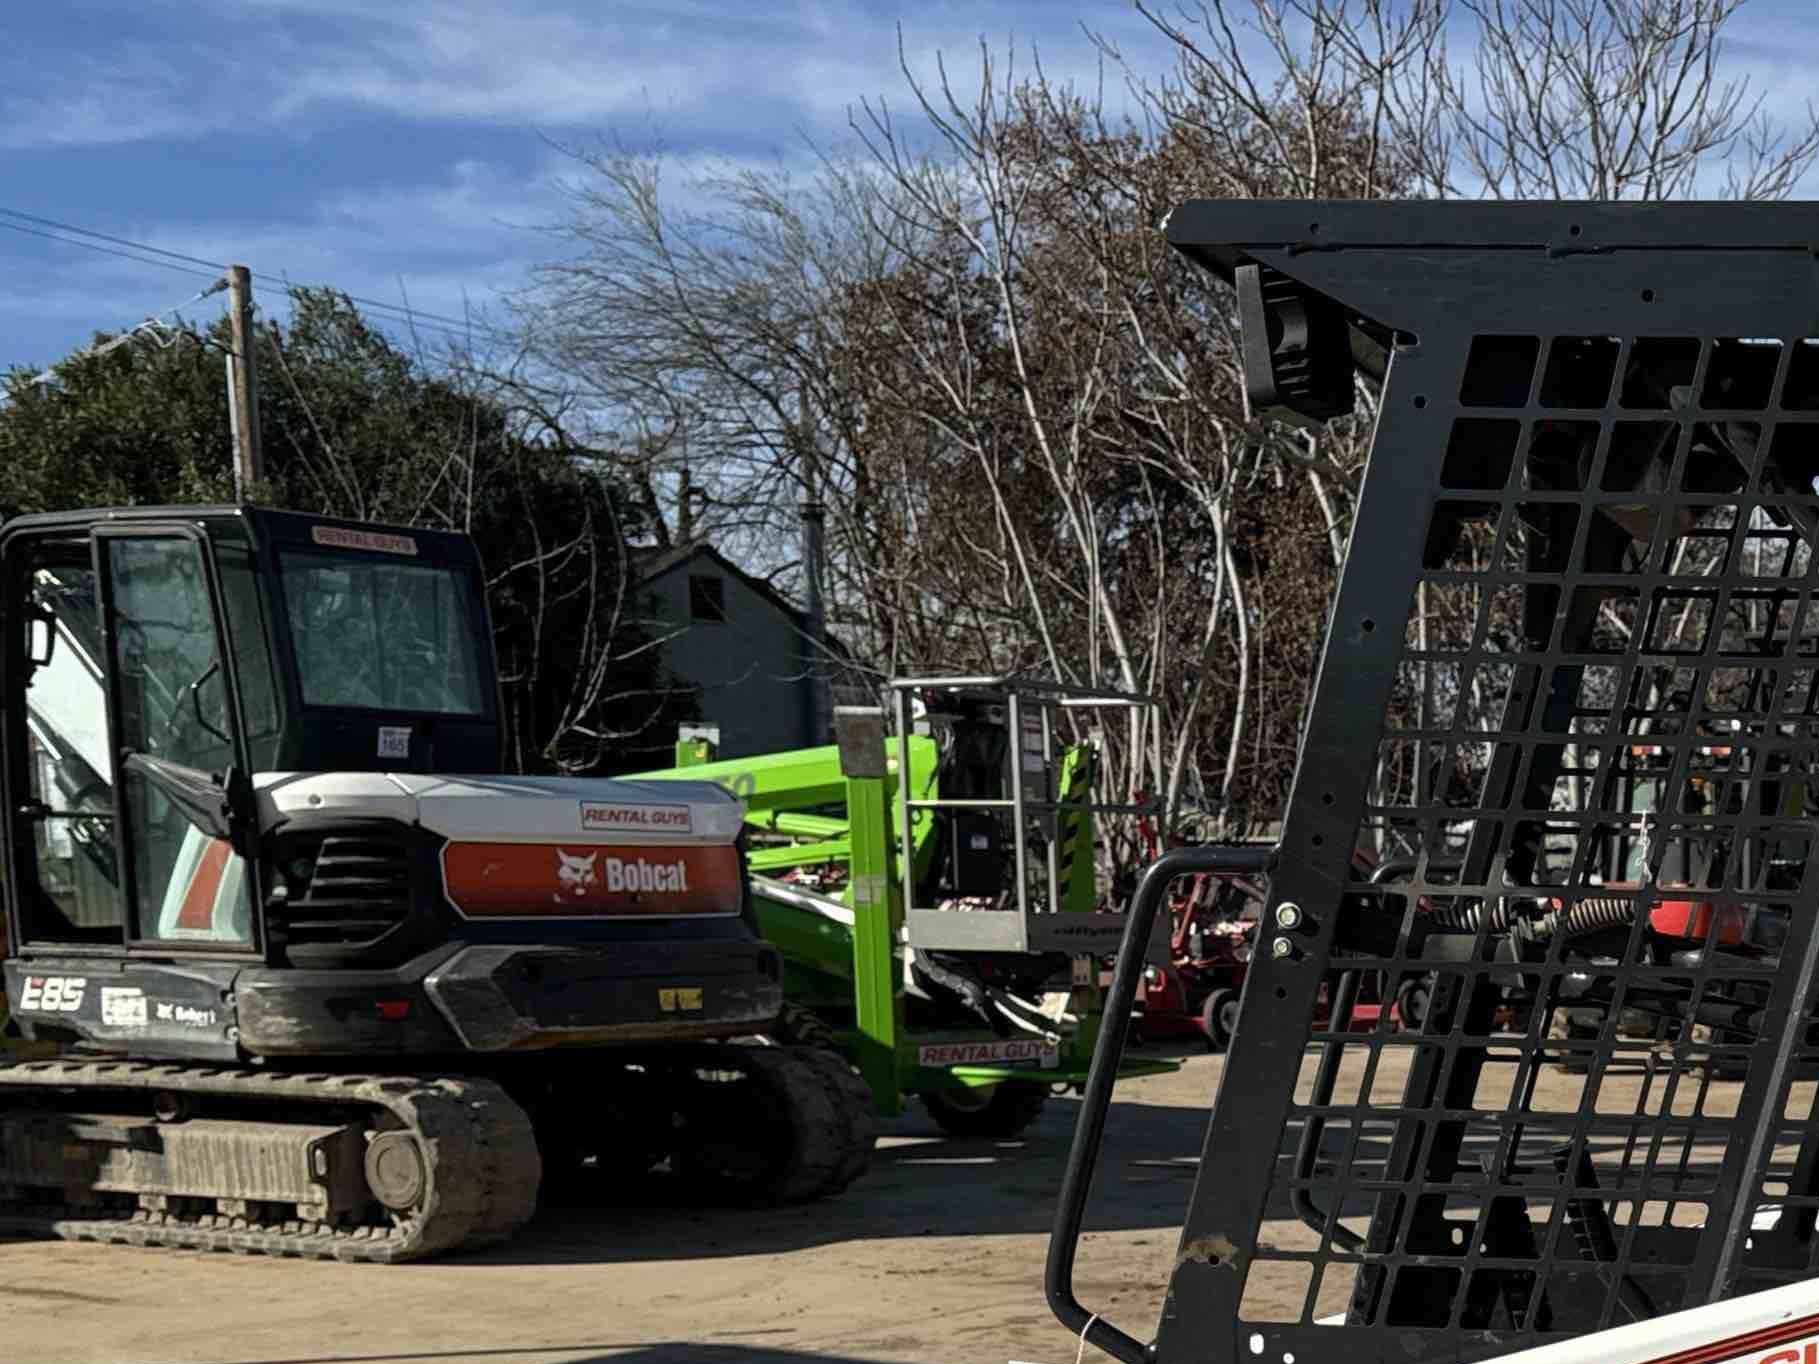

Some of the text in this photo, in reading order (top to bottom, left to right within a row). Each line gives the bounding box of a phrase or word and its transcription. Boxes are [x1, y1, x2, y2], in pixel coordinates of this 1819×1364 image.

[584, 808, 689, 825] RENTAL GUYS
[605, 858, 689, 893] Bobcat
[20, 976, 87, 1011] E85
[922, 1040, 1056, 1064] RENTAL GUYS
